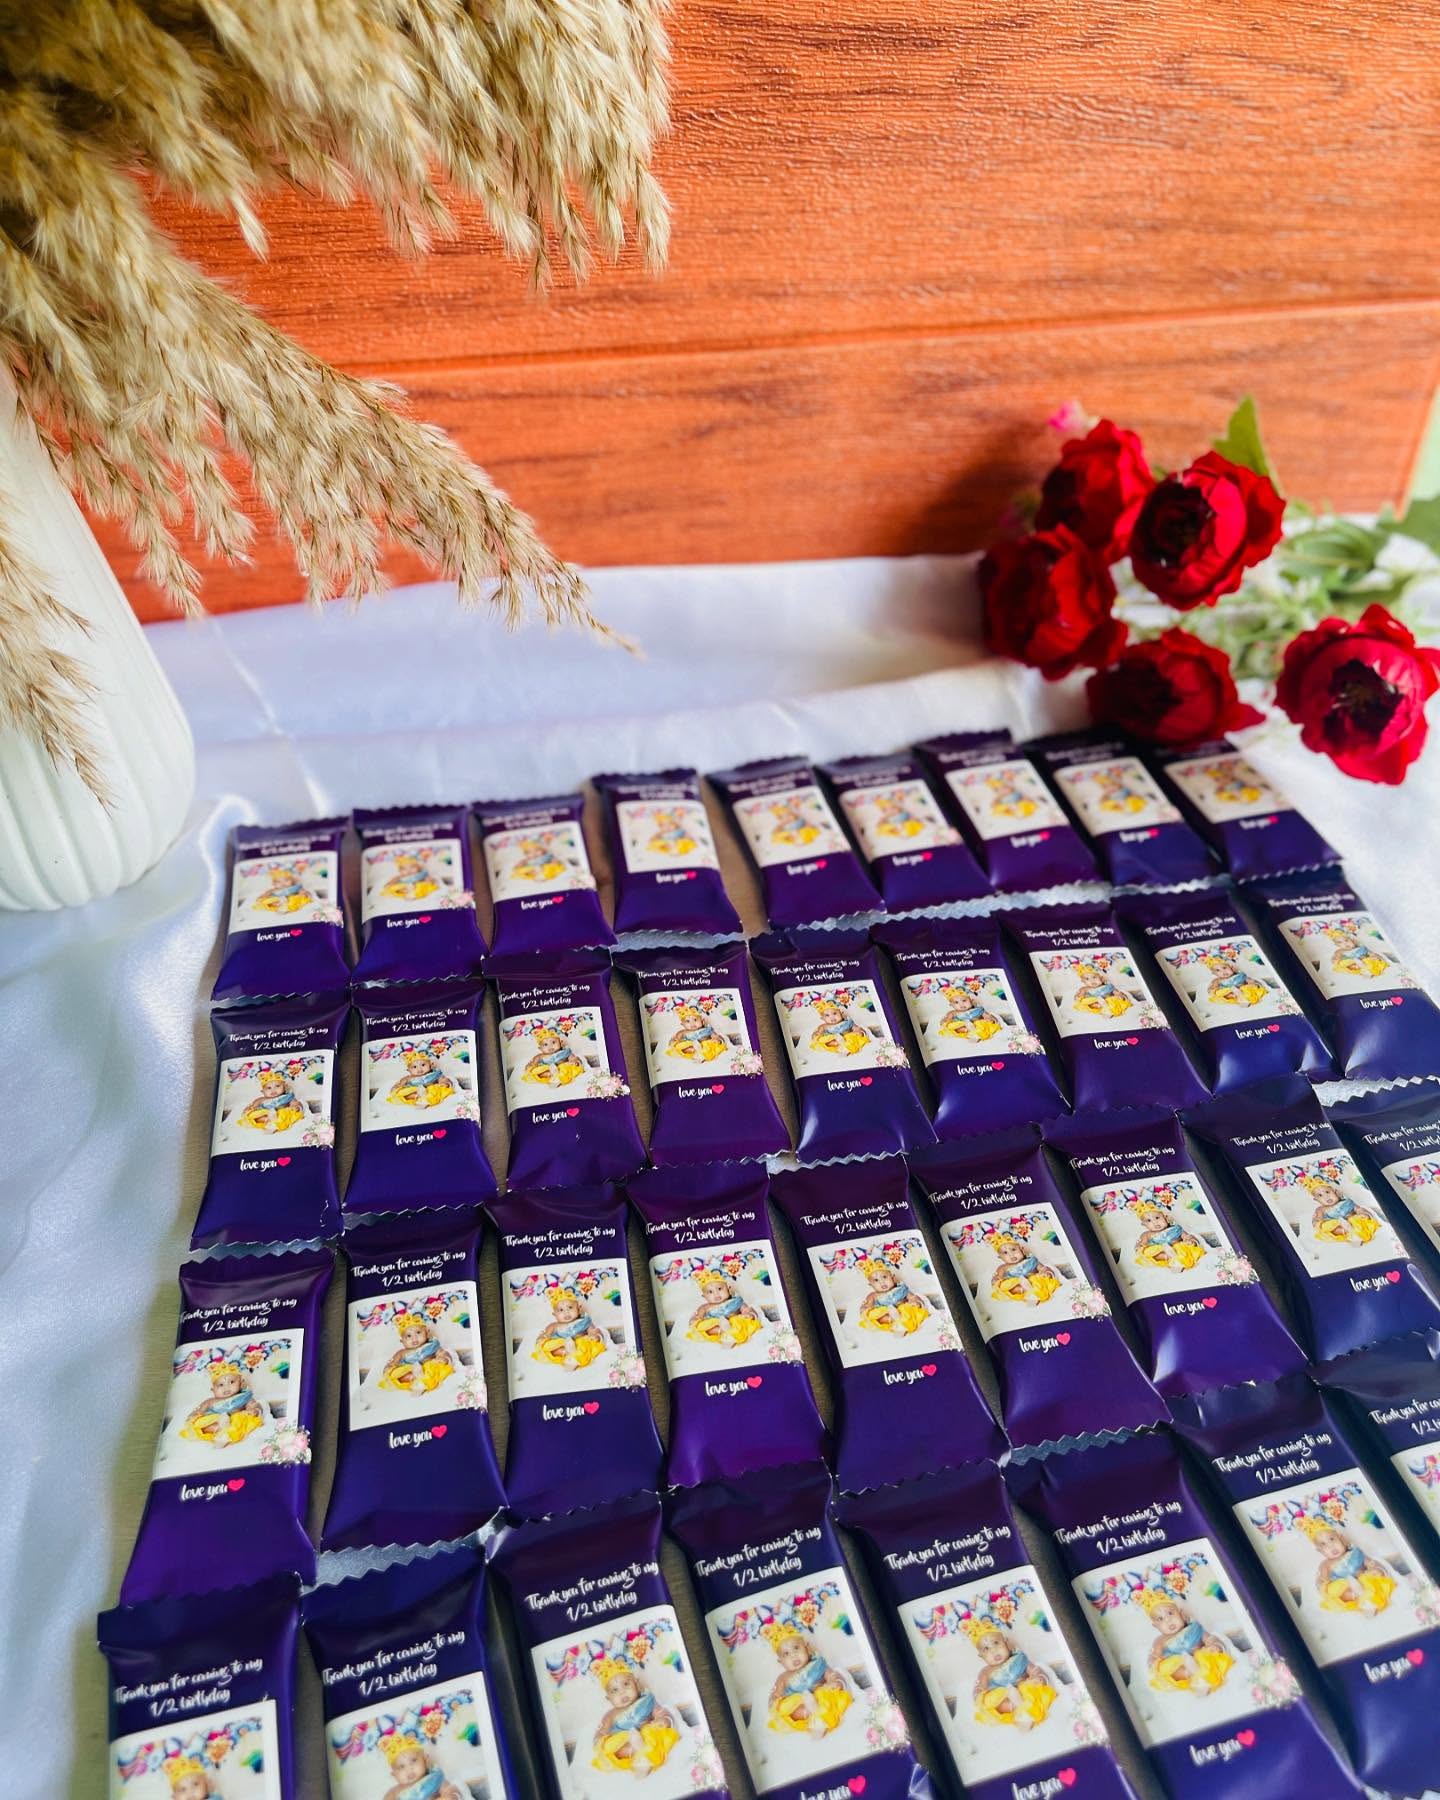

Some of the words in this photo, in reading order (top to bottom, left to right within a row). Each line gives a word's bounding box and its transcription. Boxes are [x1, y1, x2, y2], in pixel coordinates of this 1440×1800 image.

[1359, 998, 1379, 1009] love
[1378, 999, 1394, 1010] you
[1235, 1029, 1254, 1040] love
[1254, 1028, 1270, 1039] you
[1094, 1039, 1112, 1050] love
[1112, 1039, 1129, 1050] you
[957, 1064, 976, 1076] love
[977, 1064, 993, 1076] you
[678, 1086, 697, 1099] love
[697, 1087, 713, 1100] you
[827, 1079, 845, 1092] love
[846, 1079, 862, 1092] you
[532, 1112, 550, 1124] love
[551, 1111, 567, 1123] you
[395, 1134, 416, 1146] love
[416, 1133, 434, 1145] you
[1258, 1134, 1270, 1143] you
[1270, 1130, 1283, 1139] for
[1309, 1123, 1318, 1131] to
[1319, 1122, 1331, 1130] my
[1266, 1143, 1287, 1154] 1/2
[240, 1159, 259, 1172] love
[260, 1160, 277, 1173] you
[828, 1214, 844, 1223] you
[843, 1208, 857, 1219] for
[885, 1202, 894, 1211] to
[896, 1201, 909, 1210] my
[529, 1235, 547, 1245] you
[547, 1230, 561, 1242] for
[591, 1226, 601, 1236] to
[602, 1228, 616, 1237] my
[834, 1223, 856, 1234] 1/2
[533, 1247, 555, 1258] 1/2
[378, 1264, 395, 1274] you
[395, 1258, 410, 1270] for
[441, 1251, 451, 1261] to
[452, 1251, 466, 1260] my
[382, 1275, 404, 1287] 1/2
[1350, 1278, 1372, 1292] love
[1371, 1276, 1390, 1292] you
[1163, 1302, 1187, 1316] love
[1186, 1301, 1205, 1316] you
[1018, 1338, 1041, 1353] love
[1040, 1337, 1059, 1353] you
[883, 1370, 906, 1385] love
[906, 1368, 924, 1385] you
[705, 1381, 729, 1397] love
[729, 1380, 749, 1397] you
[543, 1404, 566, 1421] love
[566, 1406, 585, 1422] you
[1368, 1408, 1400, 1425] Thank
[1399, 1405, 1415, 1420] you
[1411, 1398, 1428, 1414] for
[1411, 1420, 1436, 1435] 1/2
[389, 1431, 413, 1449] love
[413, 1430, 432, 1448] you
[1211, 1455, 1244, 1472] Thank
[1243, 1453, 1261, 1467] you
[1258, 1445, 1275, 1460] for
[1276, 1440, 1312, 1457] coming
[1302, 1434, 1316, 1447] to
[1316, 1433, 1332, 1445] my
[1255, 1467, 1281, 1484] 1/2
[1278, 1458, 1320, 1477] birthday
[181, 1484, 205, 1501] love
[206, 1483, 228, 1500] you
[1054, 1525, 1085, 1544] Thank
[1085, 1521, 1104, 1537] you
[1101, 1515, 1119, 1531] for
[1121, 1508, 1159, 1526] coming
[1149, 1502, 1164, 1515] to
[1165, 1501, 1181, 1513] my
[883, 1550, 917, 1570] Thank
[917, 1547, 935, 1564] you
[933, 1539, 950, 1557] for
[951, 1533, 989, 1551] coming
[980, 1526, 994, 1540] to
[995, 1526, 1011, 1539] my
[1096, 1537, 1123, 1555] 1/2
[1121, 1527, 1166, 1547] birthday
[695, 1556, 726, 1576] Thank
[725, 1553, 743, 1569] you
[742, 1544, 759, 1561] for
[761, 1536, 798, 1554] coming
[791, 1529, 804, 1542] to
[805, 1527, 821, 1540] my
[733, 1568, 759, 1587] 1/2
[758, 1556, 802, 1578] birthday
[927, 1564, 953, 1582] 1/2
[951, 1553, 995, 1575] birthday
[524, 1590, 560, 1610] Thank
[559, 1587, 579, 1603] you
[578, 1577, 595, 1595] for
[597, 1569, 635, 1589] coming
[628, 1562, 642, 1577] to
[644, 1561, 659, 1575] my
[566, 1602, 593, 1621] 1/2
[593, 1590, 637, 1613] birthday
[322, 1665, 353, 1686] Thank
[352, 1660, 375, 1677] you
[374, 1650, 394, 1669] for
[396, 1640, 437, 1661] coming
[432, 1633, 446, 1648] to
[447, 1631, 465, 1644] my
[359, 1676, 388, 1695] 1/2
[388, 1662, 438, 1686] birthday
[1364, 1662, 1390, 1683] love
[1390, 1657, 1411, 1680] you
[114, 1684, 147, 1703] Thank
[147, 1681, 169, 1697] you
[170, 1673, 189, 1690] for
[191, 1667, 233, 1687] coming
[230, 1660, 243, 1674] to
[245, 1658, 263, 1672] my
[150, 1698, 178, 1717] 1/2
[179, 1688, 231, 1709] birthday
[1190, 1745, 1218, 1766] love
[1218, 1739, 1241, 1762] you
[1011, 1782, 1039, 1800] love
[1040, 1777, 1062, 1800] you
